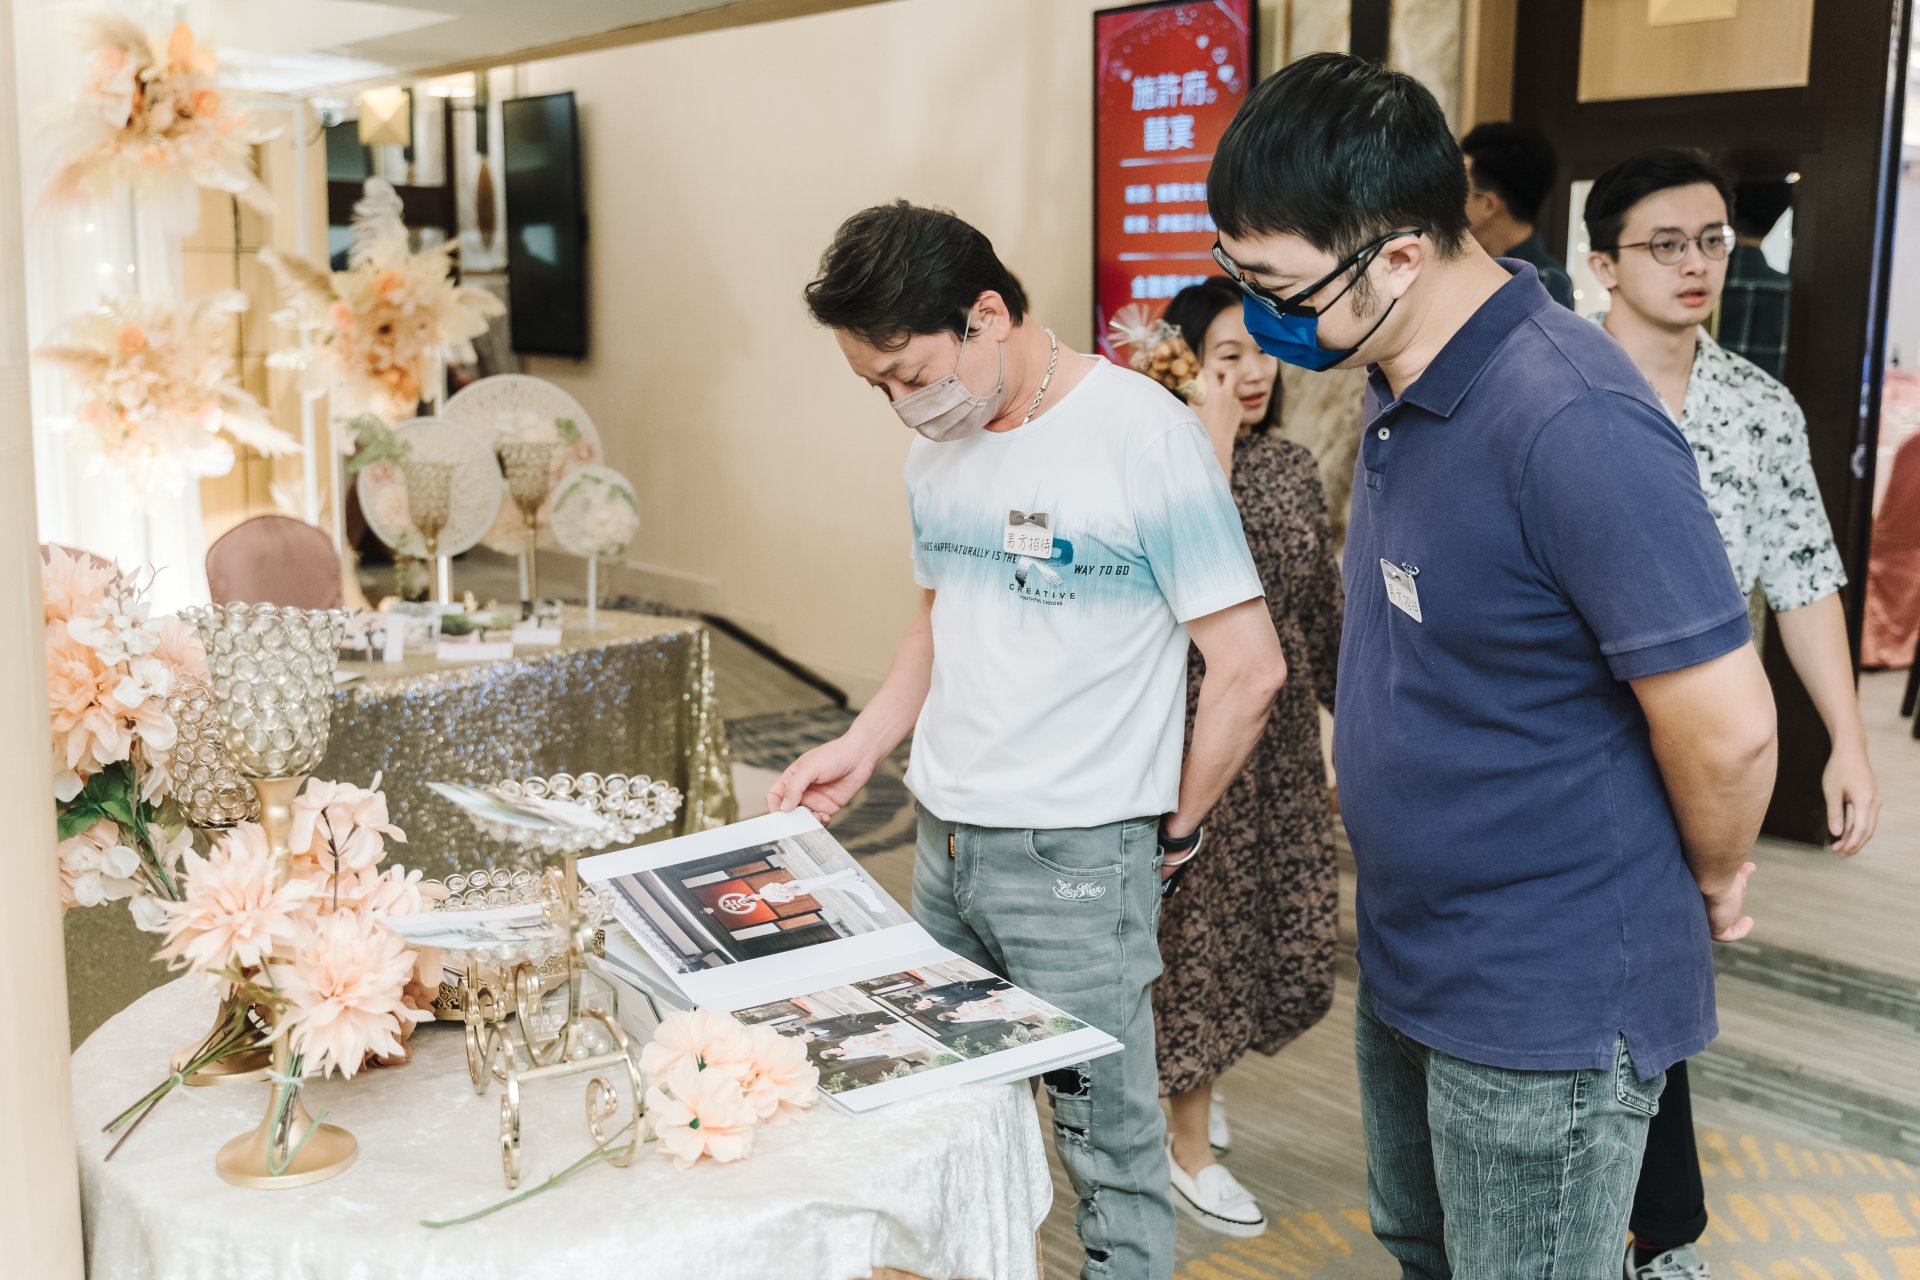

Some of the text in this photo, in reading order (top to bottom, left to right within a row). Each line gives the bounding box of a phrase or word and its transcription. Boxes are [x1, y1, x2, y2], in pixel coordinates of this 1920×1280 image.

[1007, 532, 1051, 554] 男方招待
[991, 550, 1001, 560] IS
[1003, 552, 1017, 564] THE
[1074, 564, 1095, 576] WAY
[1099, 565, 1112, 576] TO
[1116, 565, 1130, 575] GO
[1009, 583, 1076, 600] CREATIVE
